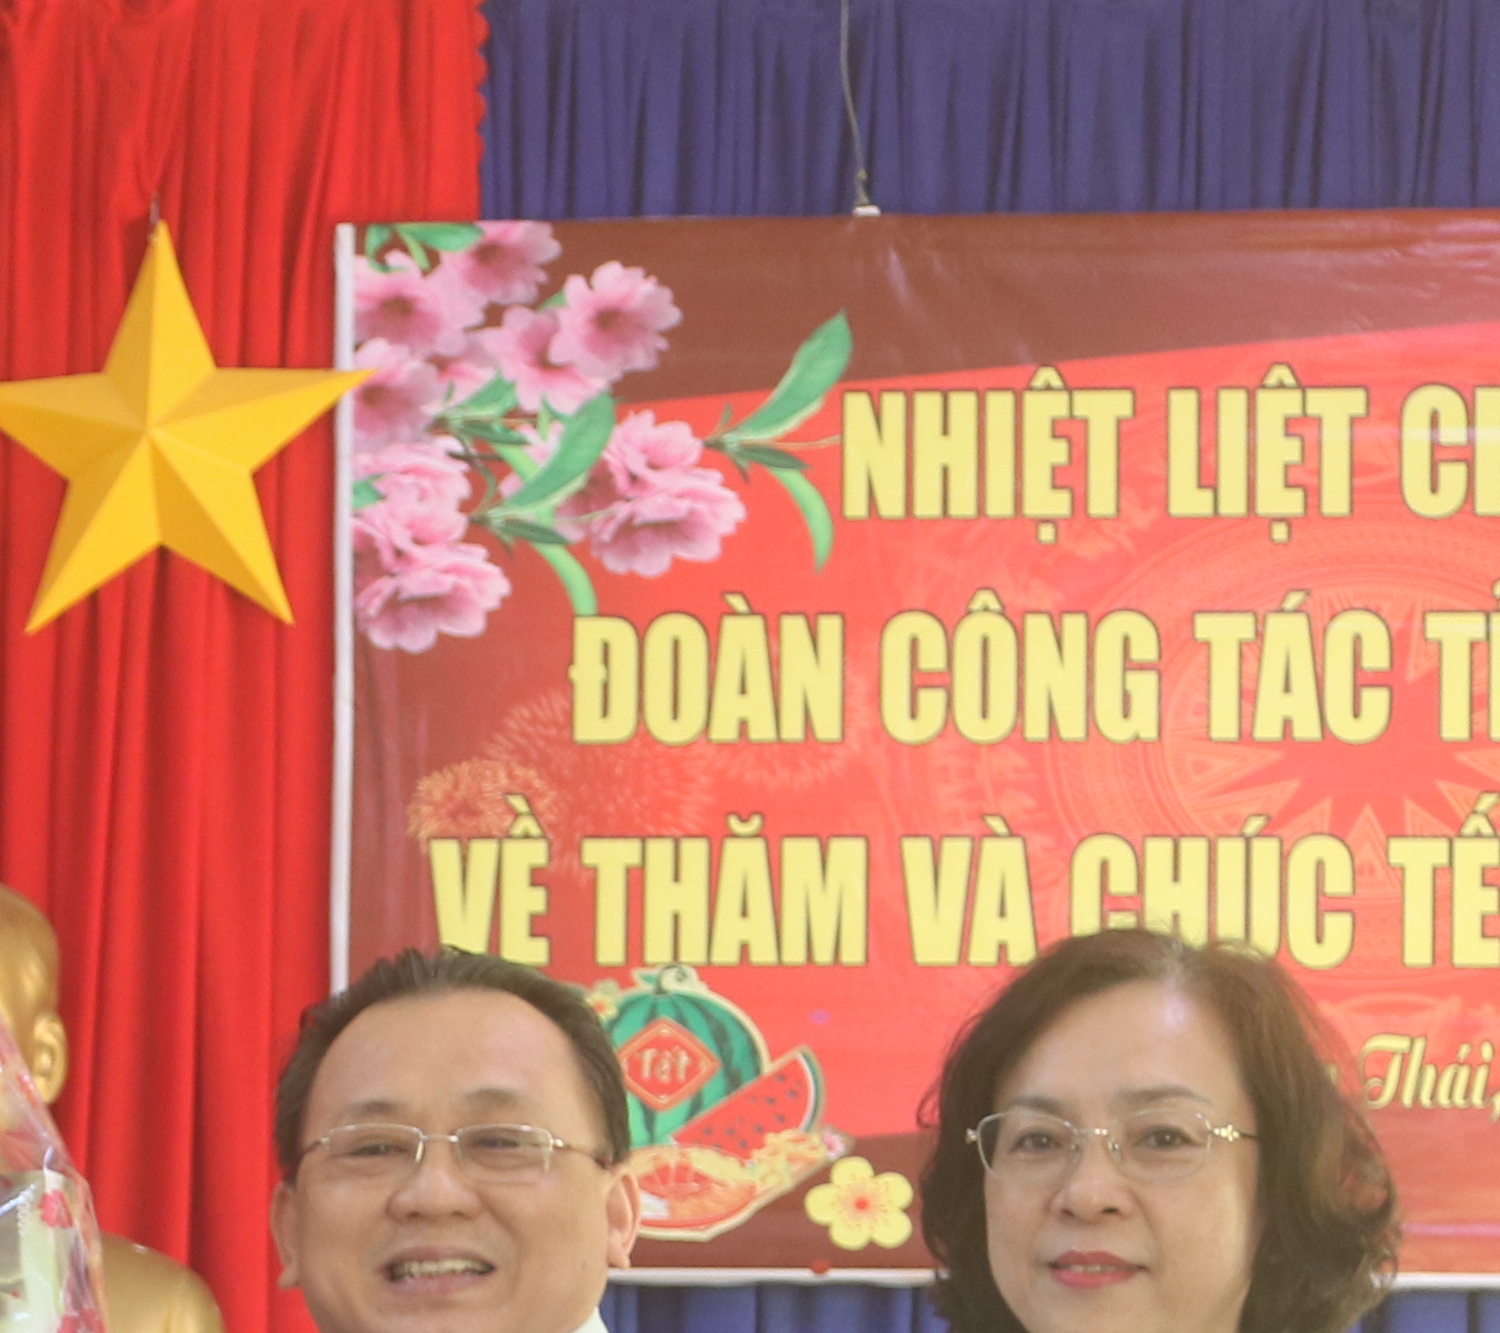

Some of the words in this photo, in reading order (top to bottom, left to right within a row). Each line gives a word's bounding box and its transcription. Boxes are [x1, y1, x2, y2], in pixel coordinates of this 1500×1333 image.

[841, 363, 1134, 544] NHIỆT
[1166, 362, 1368, 544] LIỆT
[567, 591, 844, 747] ĐOÀN
[878, 587, 1162, 746] CÔNG
[1193, 590, 1393, 746] TÁC
[428, 792, 553, 966] VỀ
[580, 812, 869, 966] THĂM
[898, 813, 1039, 966] VÀ
[1070, 813, 1356, 969] CHÚC
